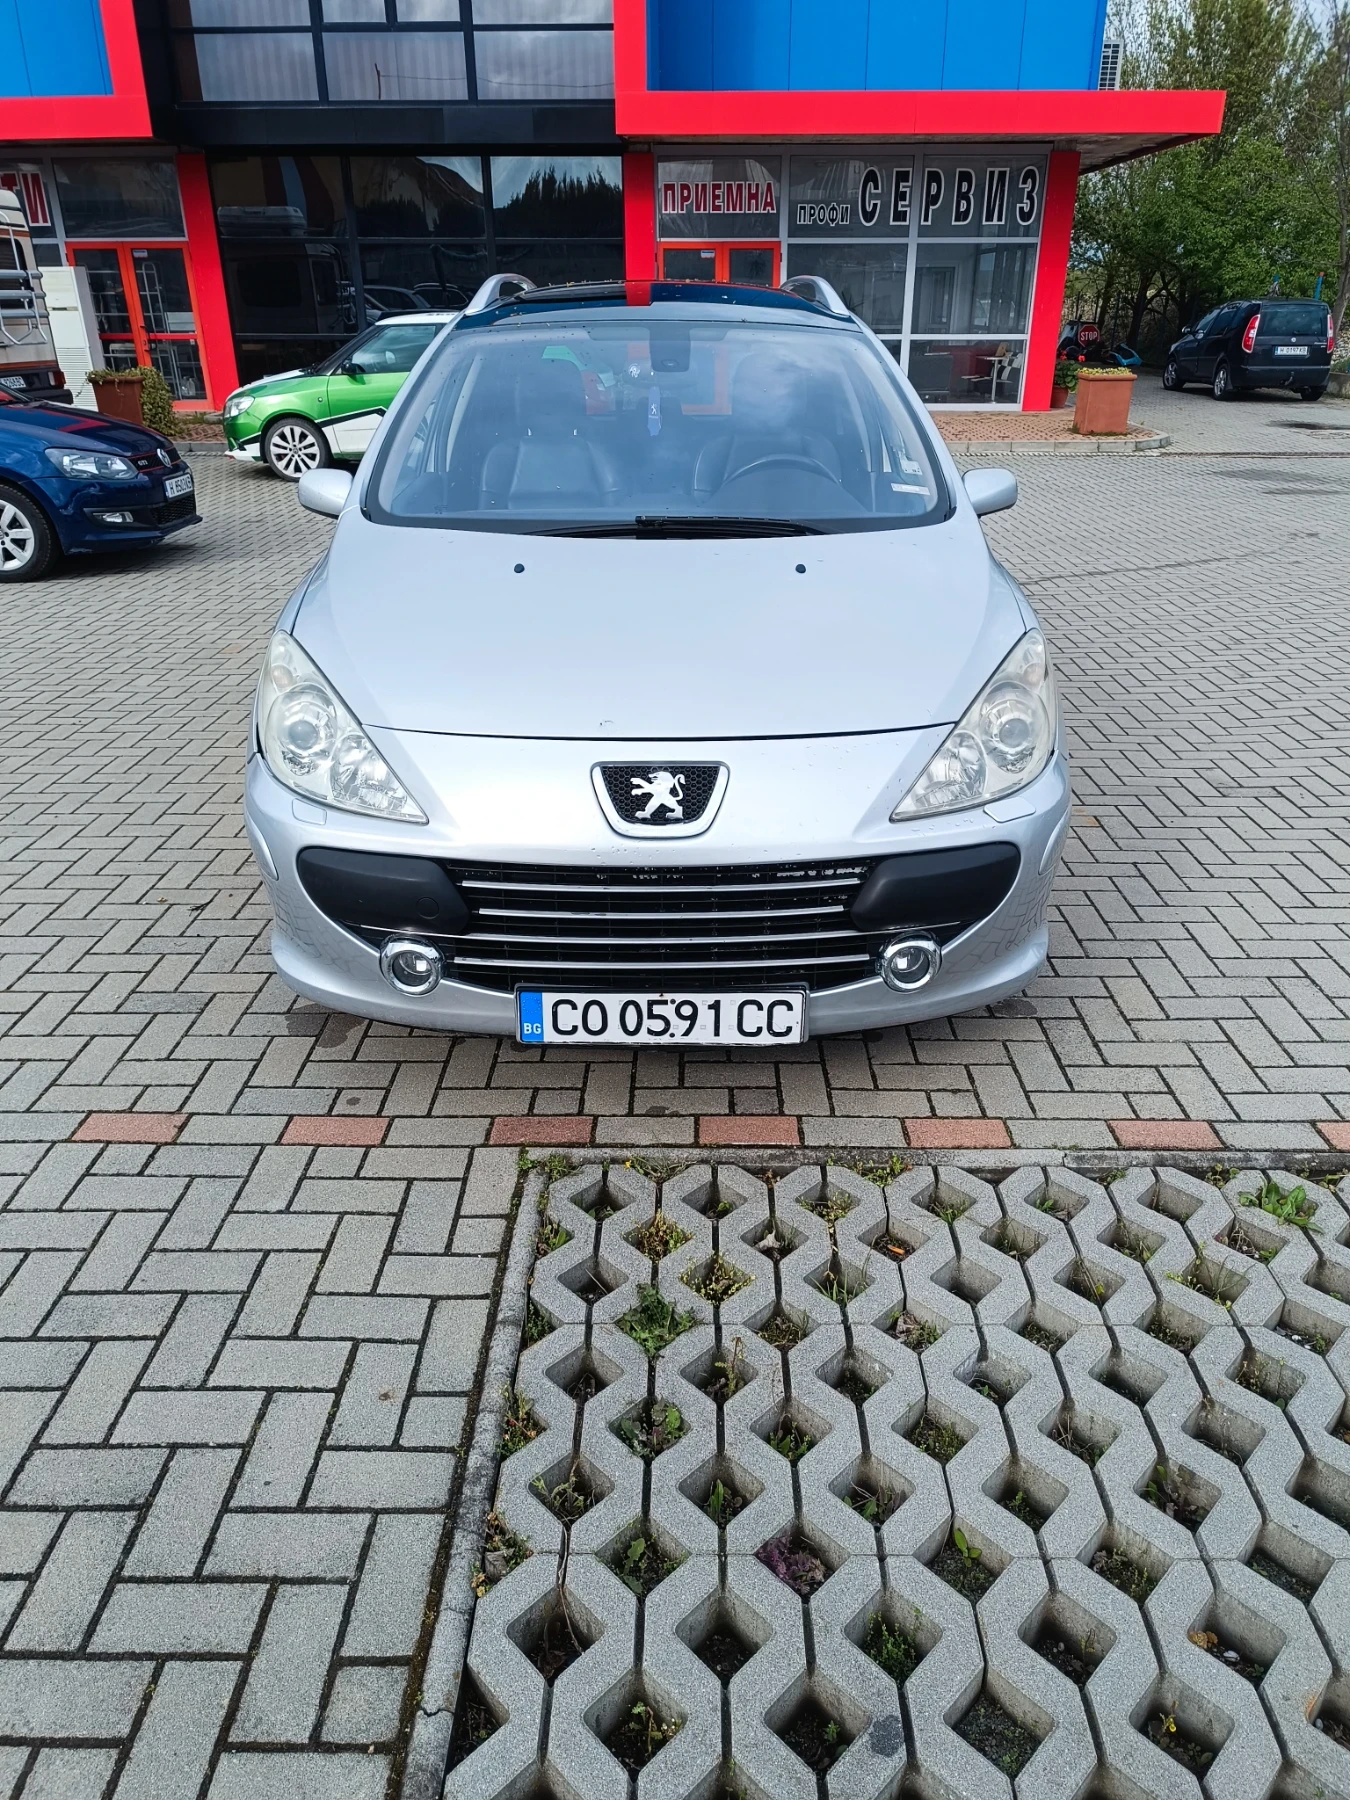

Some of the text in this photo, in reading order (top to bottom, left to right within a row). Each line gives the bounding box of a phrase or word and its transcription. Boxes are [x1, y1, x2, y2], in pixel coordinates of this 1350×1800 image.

[661, 181, 777, 214] ПРИЕМНА
[796, 166, 1040, 227] ПРОФИ СЕРВИЗ
[1080, 332, 1097, 341] STOP
[523, 1023, 542, 1035] BG
[551, 998, 794, 1038] CO 0591 CC
